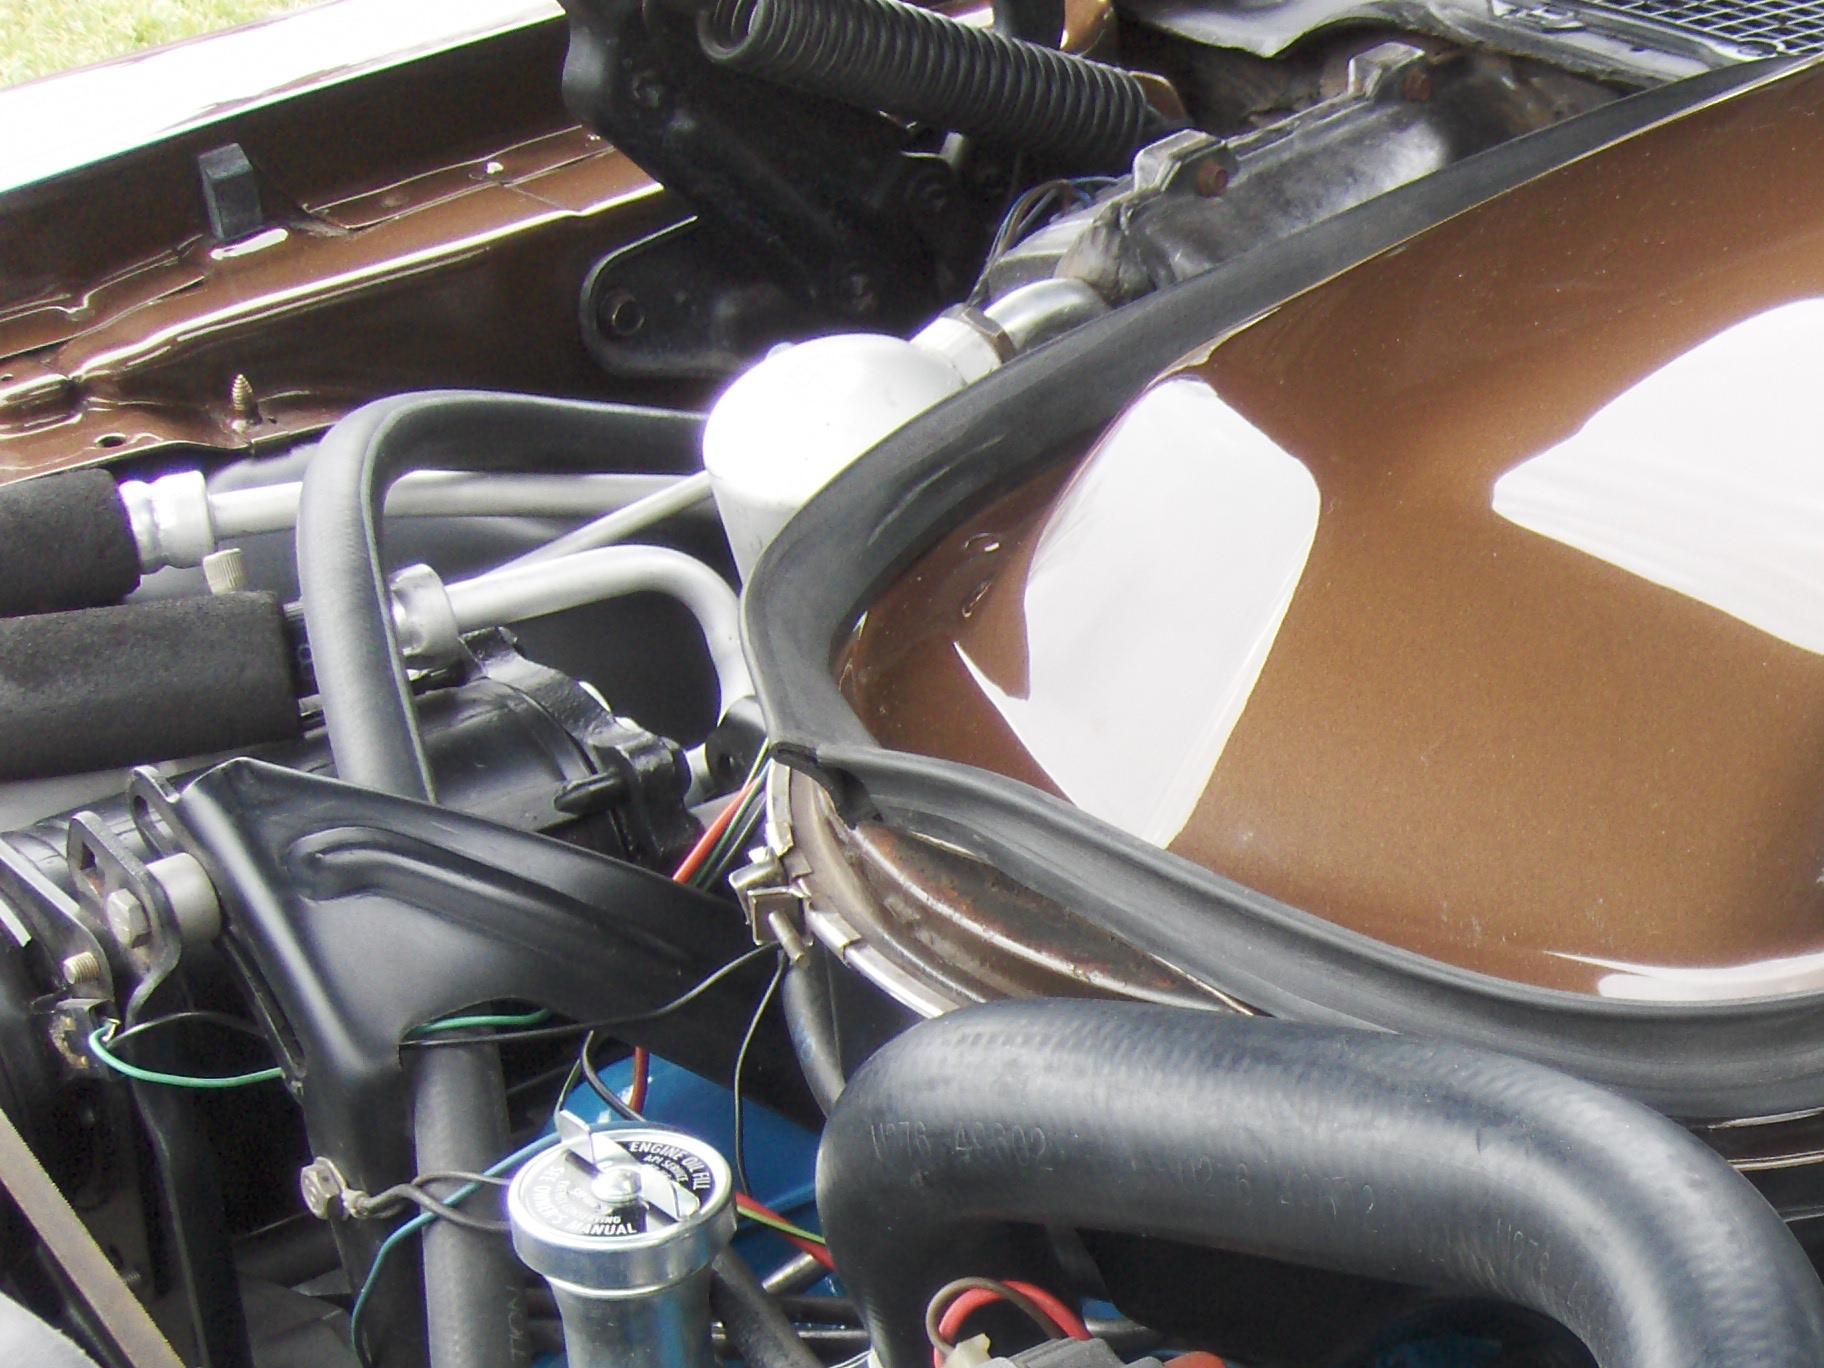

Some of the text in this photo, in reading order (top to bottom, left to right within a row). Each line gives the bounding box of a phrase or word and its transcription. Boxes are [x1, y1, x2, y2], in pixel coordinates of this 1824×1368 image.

[630, 1141, 711, 1190] ENGINE OIL FILL
[643, 1153, 664, 1165] API
[564, 1219, 637, 1235] MANUAL
